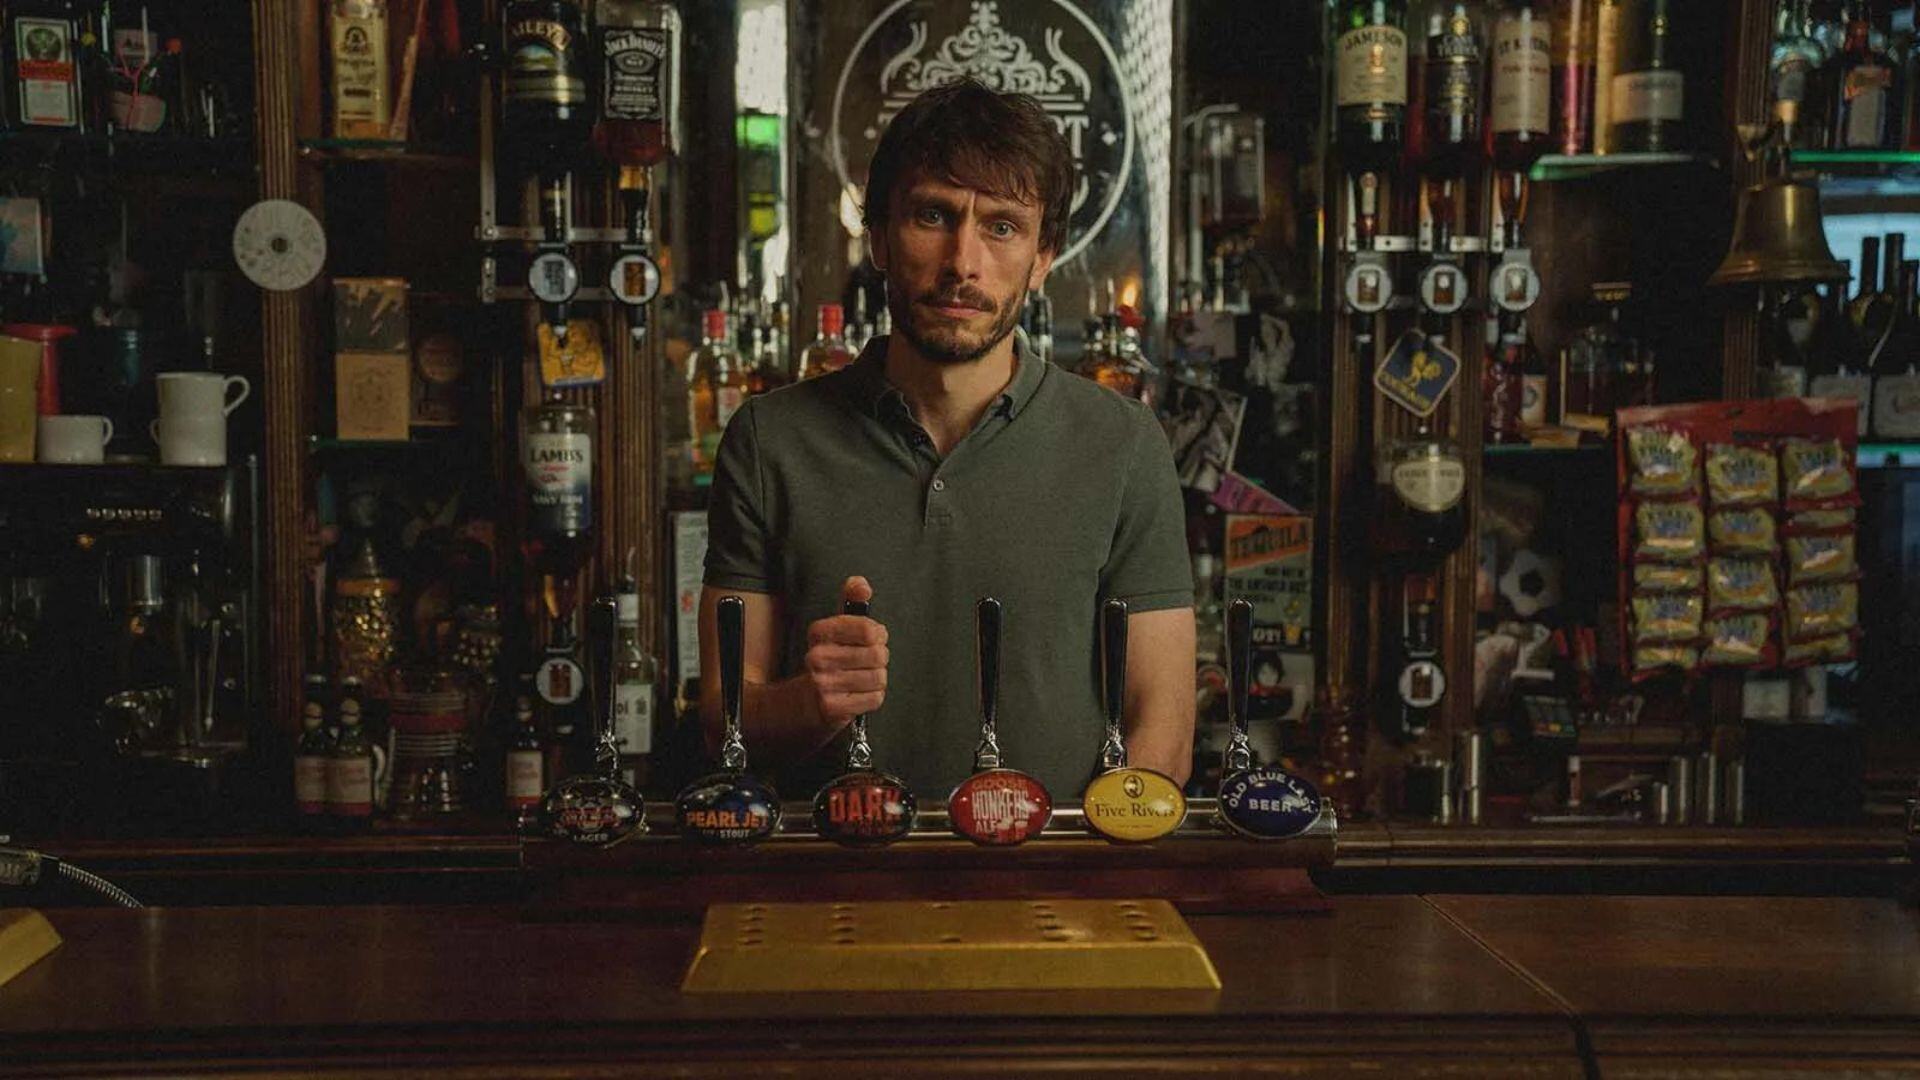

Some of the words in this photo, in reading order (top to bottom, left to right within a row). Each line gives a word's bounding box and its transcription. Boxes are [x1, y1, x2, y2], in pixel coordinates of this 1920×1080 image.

[1344, 30, 1403, 52] JAMESON
[1228, 521, 1308, 561] TEQUILA
[972, 778, 1028, 791] GOOSE
[1228, 782, 1248, 808] OLD
[1248, 771, 1287, 784] BLUE
[828, 785, 902, 823] DARK
[1095, 802, 1127, 817] Five
[1131, 802, 1176, 817] Rivers
[1248, 798, 1292, 812] BEER
[685, 809, 740, 829] PEARL
[741, 808, 768, 829] JET
[572, 832, 609, 842] LAGER
[720, 829, 751, 839] STOUT
